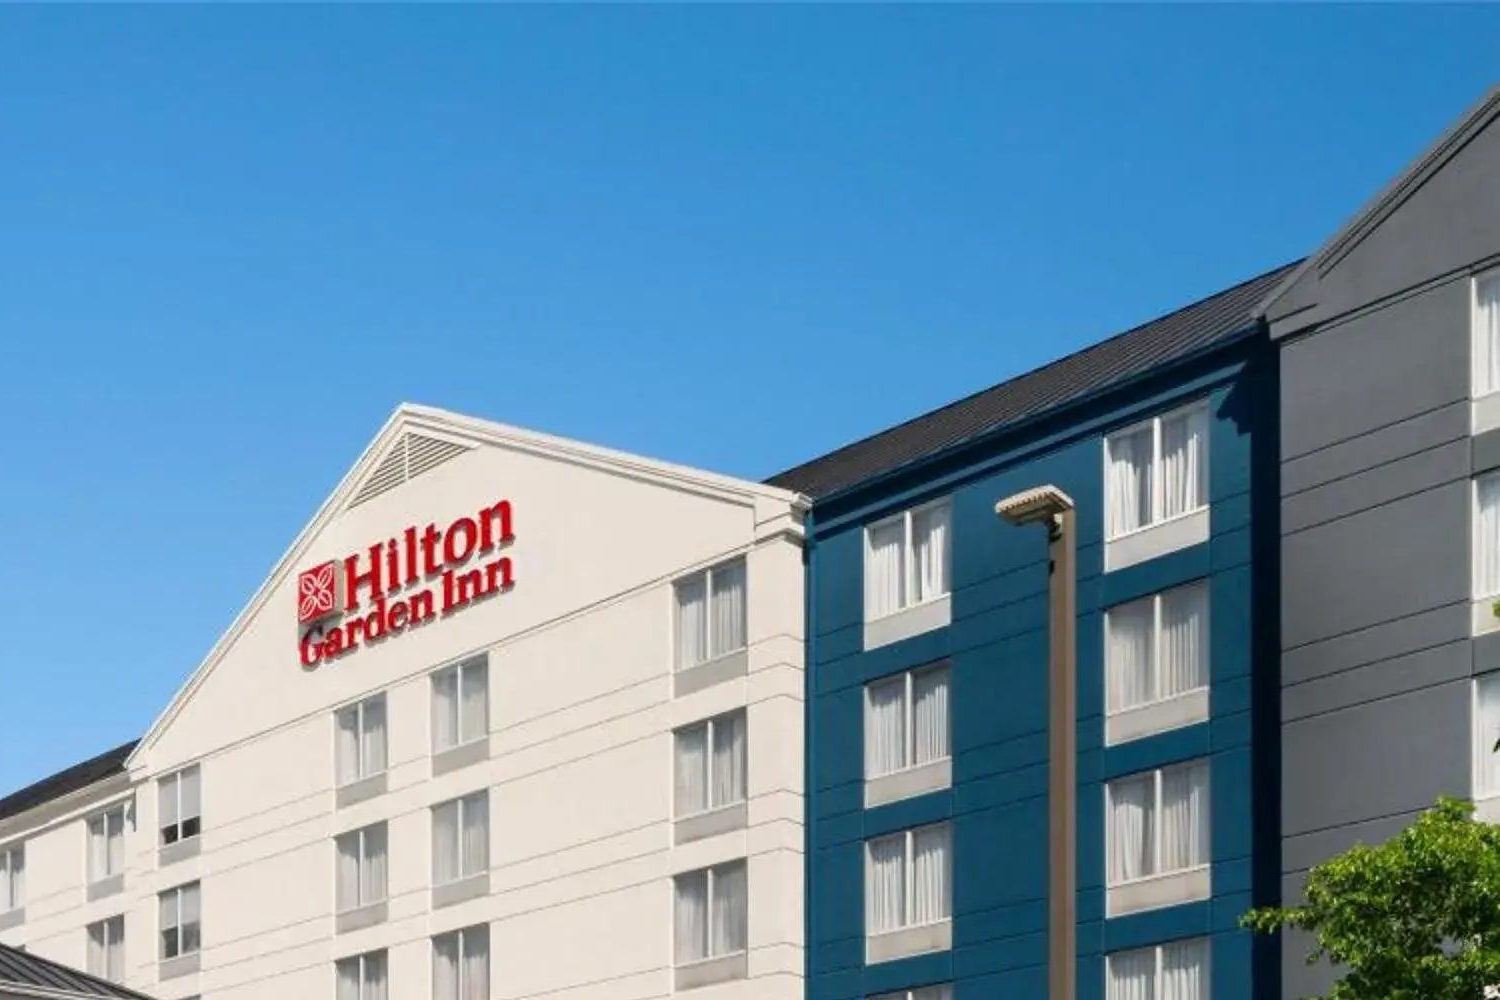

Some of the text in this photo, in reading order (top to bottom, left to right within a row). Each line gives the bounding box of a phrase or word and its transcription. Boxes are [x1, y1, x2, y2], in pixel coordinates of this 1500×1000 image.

[344, 499, 515, 611] Hilton
[299, 557, 515, 667] Garden Inn
